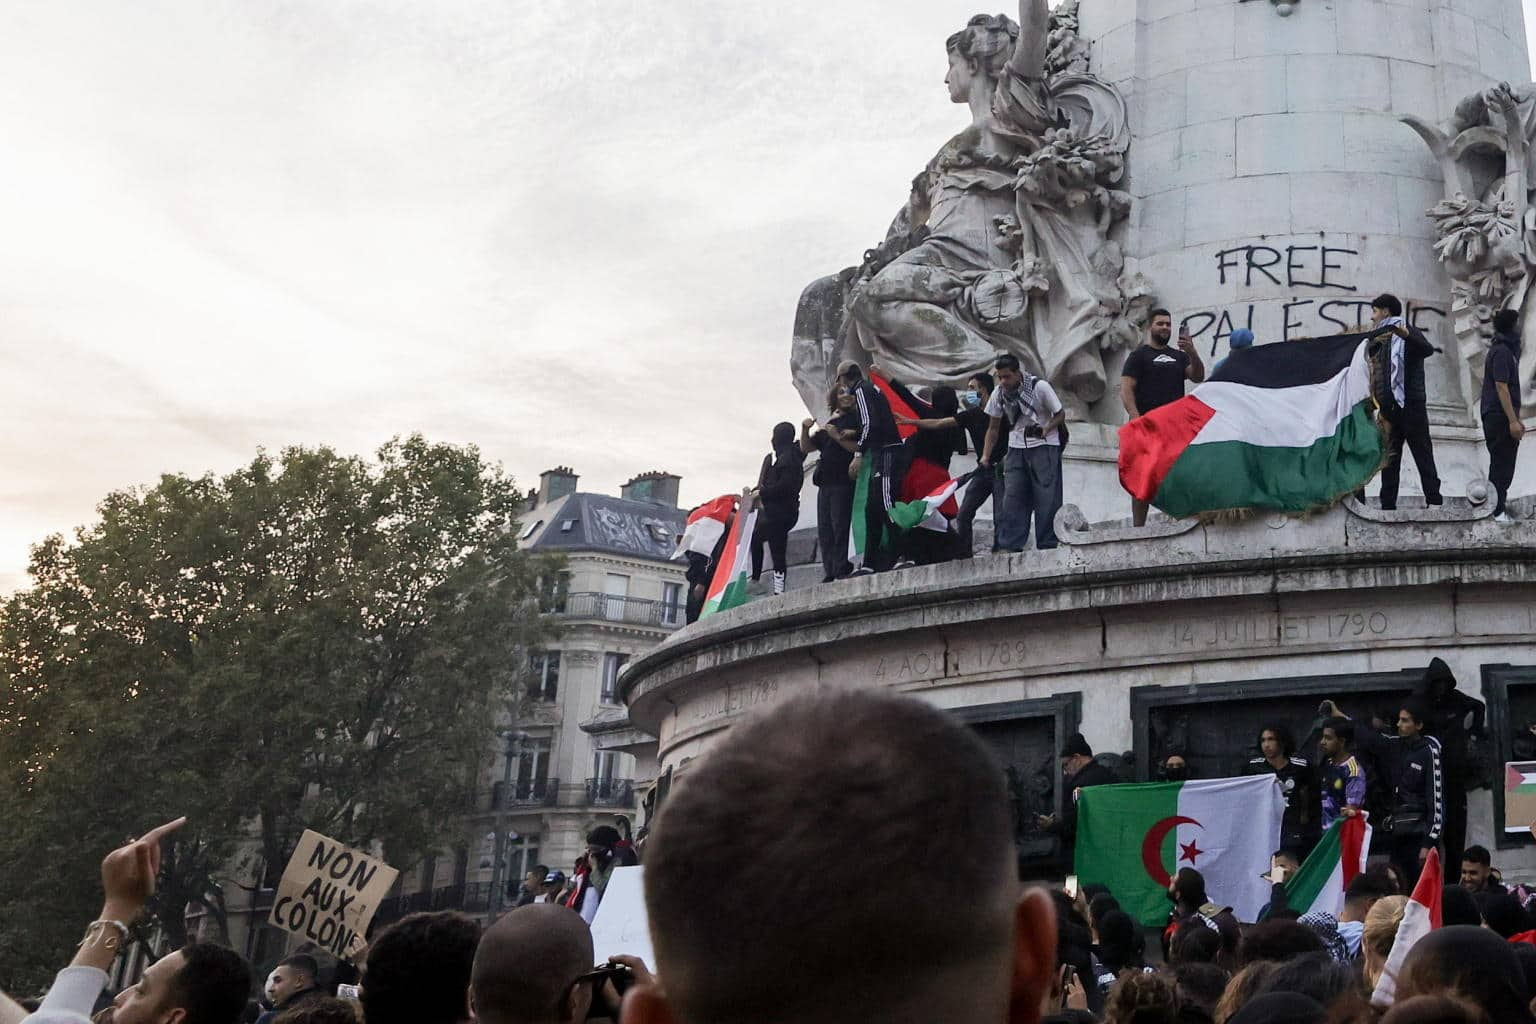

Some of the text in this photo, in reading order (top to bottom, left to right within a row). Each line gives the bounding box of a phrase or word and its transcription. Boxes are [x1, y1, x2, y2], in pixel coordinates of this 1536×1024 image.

[1215, 245, 1358, 291] FREE
[1170, 611, 1388, 648] 14 JUILLET 1790
[978, 641, 1026, 667] 1789
[308, 841, 377, 892] NON
[302, 877, 355, 921] AUX
